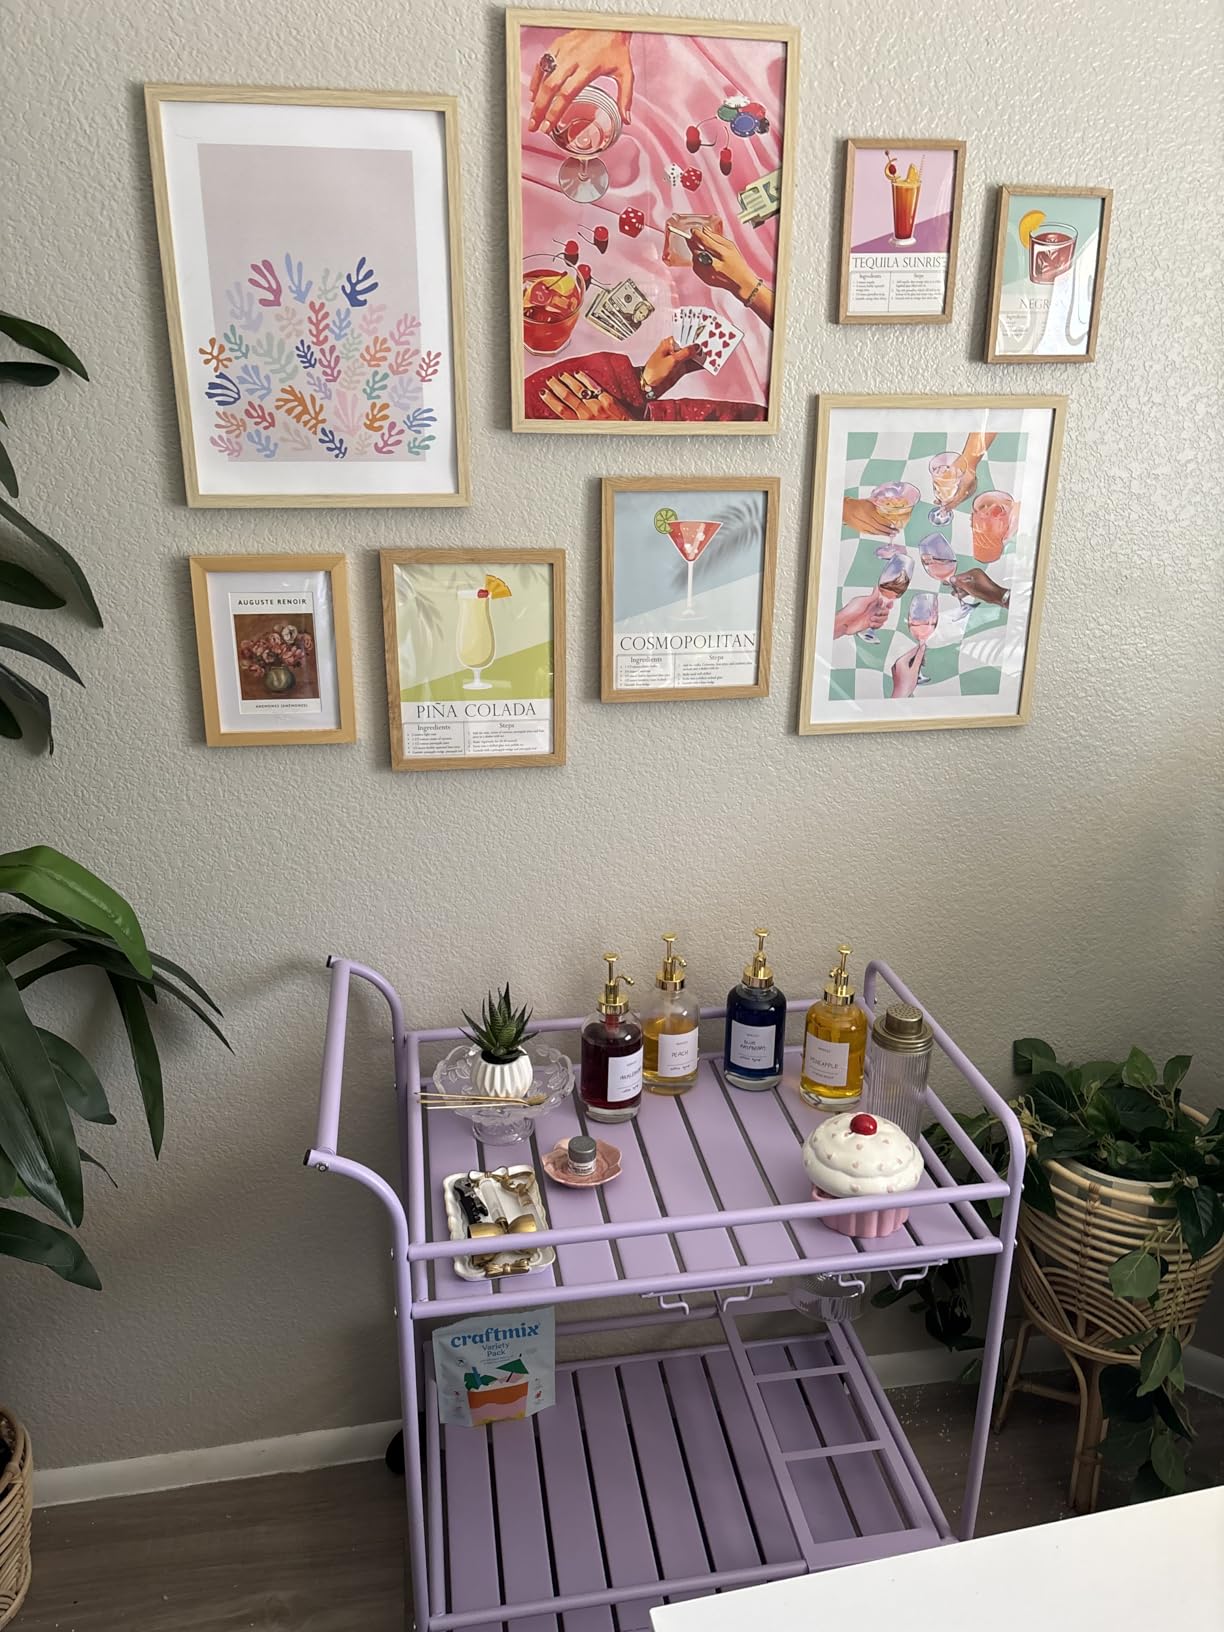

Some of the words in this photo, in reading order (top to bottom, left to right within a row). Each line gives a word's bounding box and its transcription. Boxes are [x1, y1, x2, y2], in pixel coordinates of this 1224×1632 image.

[852, 256, 899, 269] TEQUILA
[620, 633, 756, 651] COSMOPOLITAN
[417, 702, 458, 719] PIÑA
[464, 702, 536, 718] COLADA
[417, 724, 451, 732] Ingredients
[671, 1050, 689, 1058] PEACH
[451, 1323, 538, 1348] craftmix
[482, 1342, 509, 1351] Variety
[487, 1349, 506, 1357] Pack
